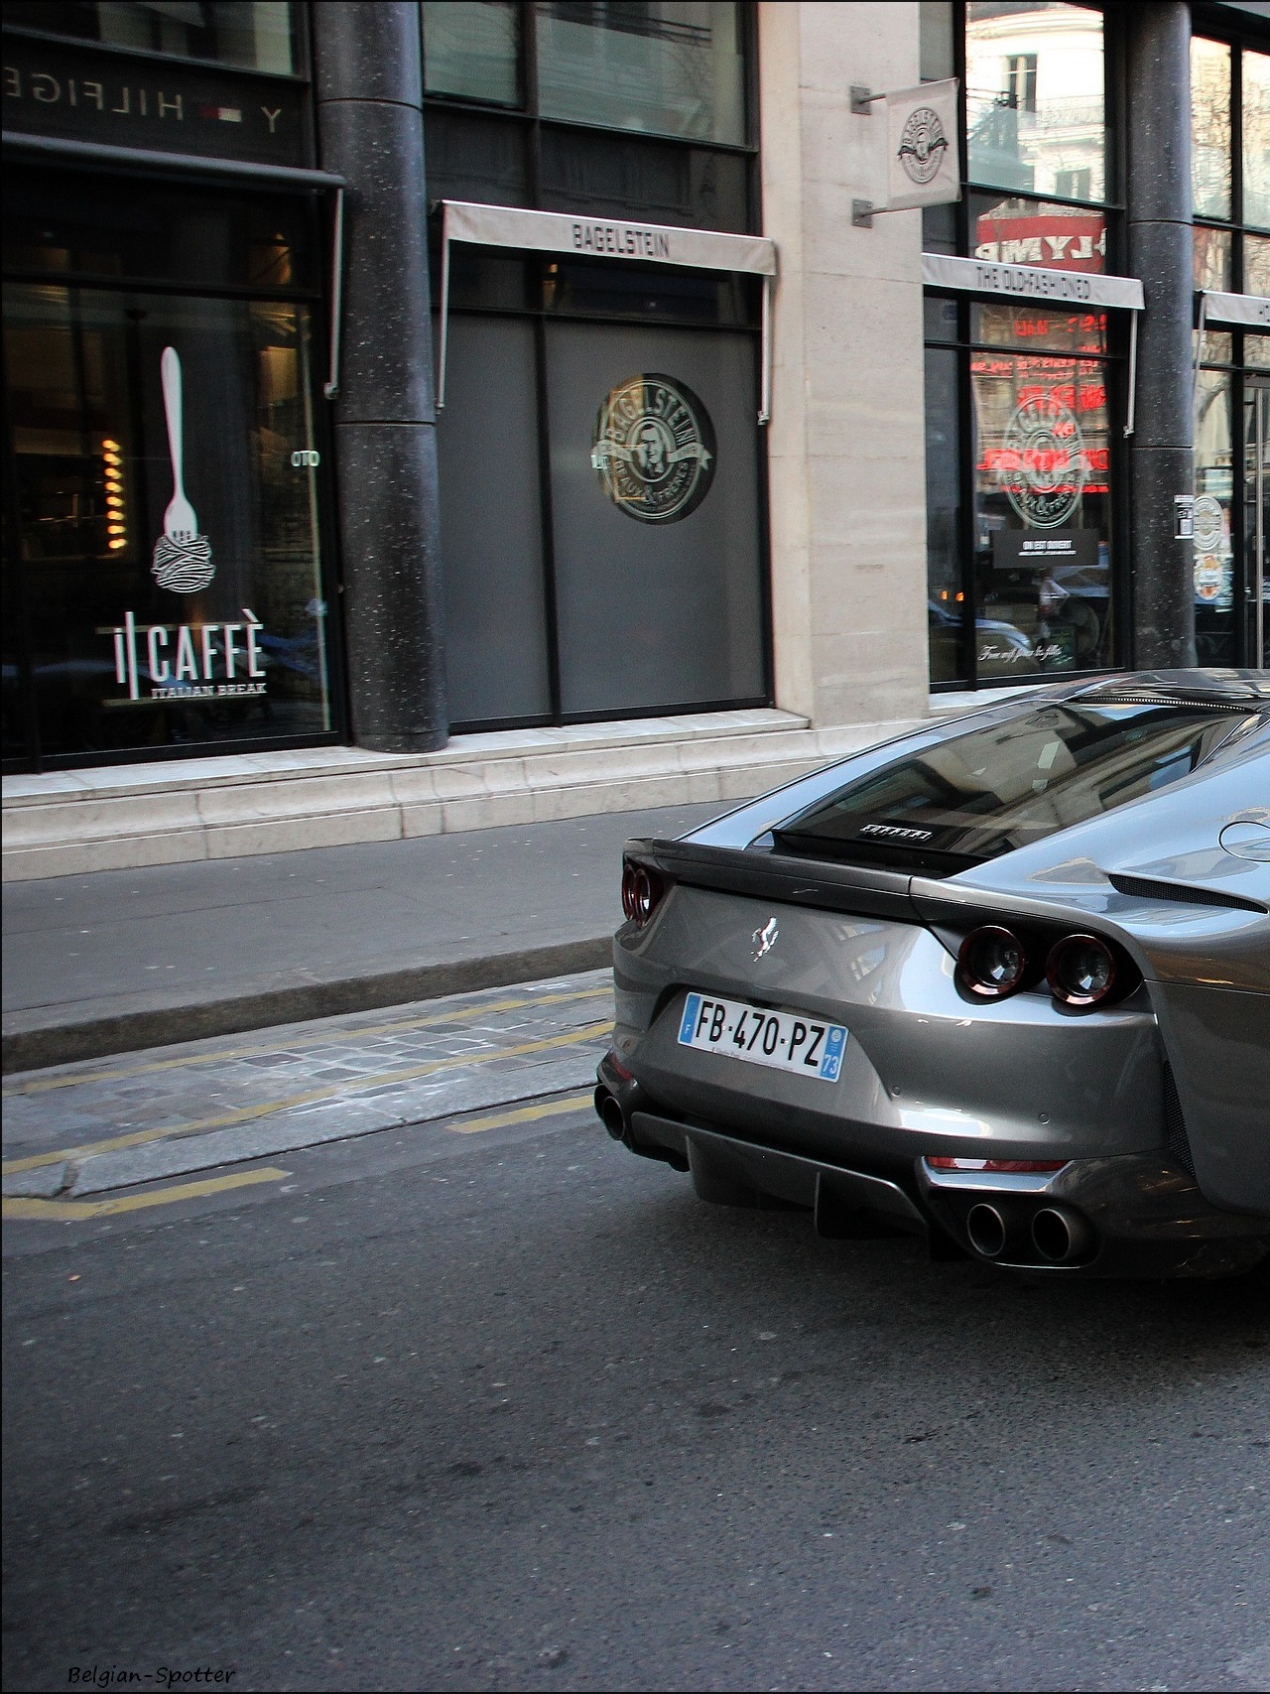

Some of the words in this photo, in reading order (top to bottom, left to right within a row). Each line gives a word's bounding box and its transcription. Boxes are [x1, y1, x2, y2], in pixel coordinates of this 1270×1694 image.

[571, 223, 670, 258] BAGELSTEIN
[604, 386, 698, 447] BAGELSTEIN
[147, 608, 267, 683] CAFFÈ
[151, 685, 214, 699] ITALIAN
[217, 682, 268, 696] BREAK
[695, 1000, 826, 1068] FB-470-PZ
[822, 1053, 840, 1076] 73
